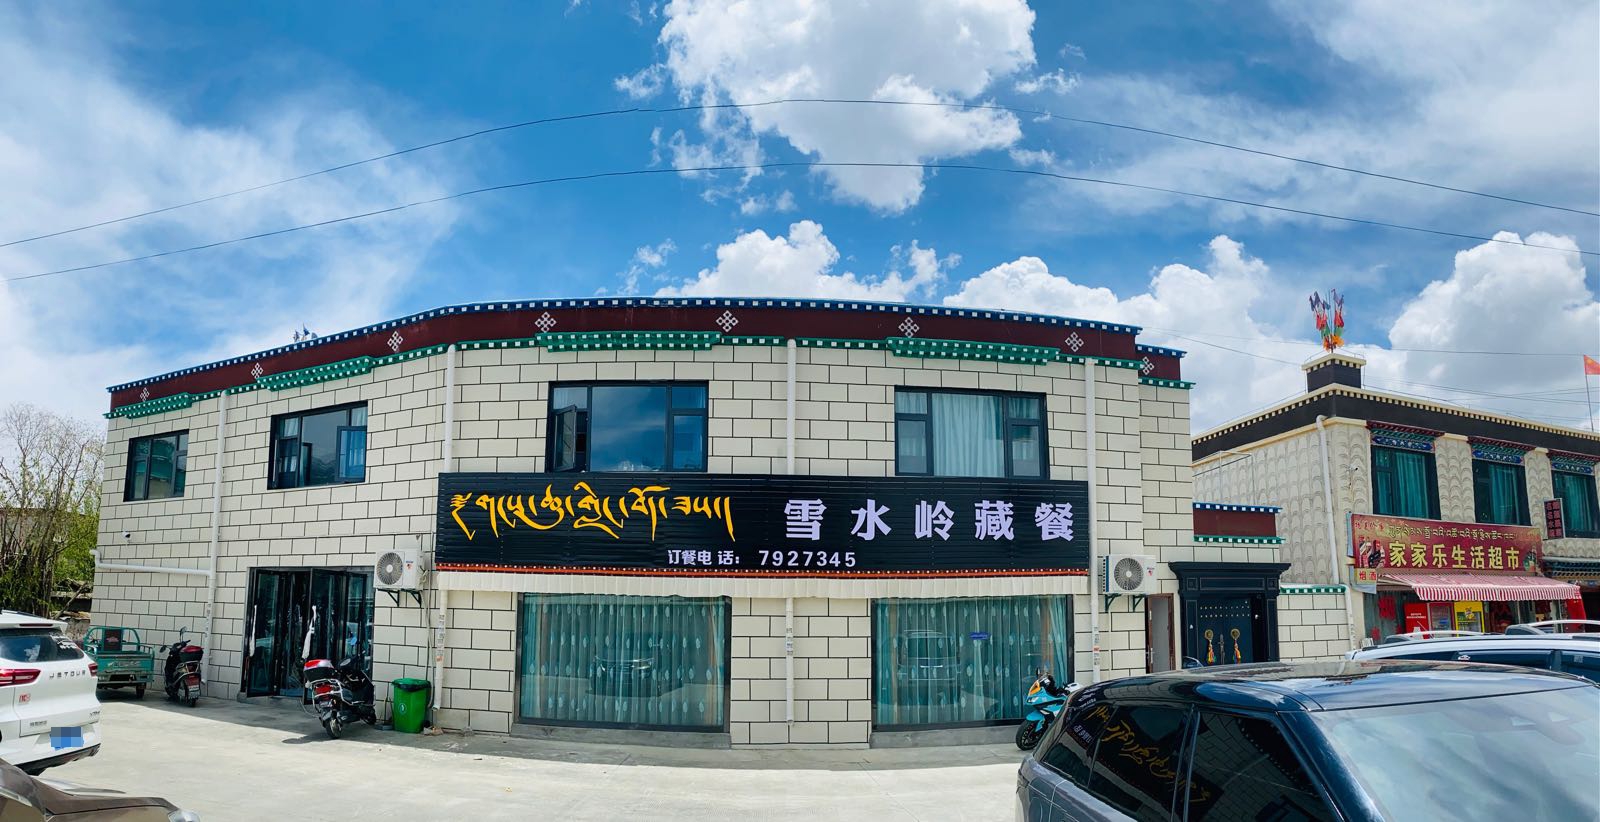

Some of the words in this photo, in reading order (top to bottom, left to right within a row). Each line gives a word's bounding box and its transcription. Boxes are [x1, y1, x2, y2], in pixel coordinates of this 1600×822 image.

[784, 499, 1074, 541] 雪水岭藏餐
[757, 550, 857, 567] 7927345
[1389, 542, 1520, 569] 家家乐生活超市
